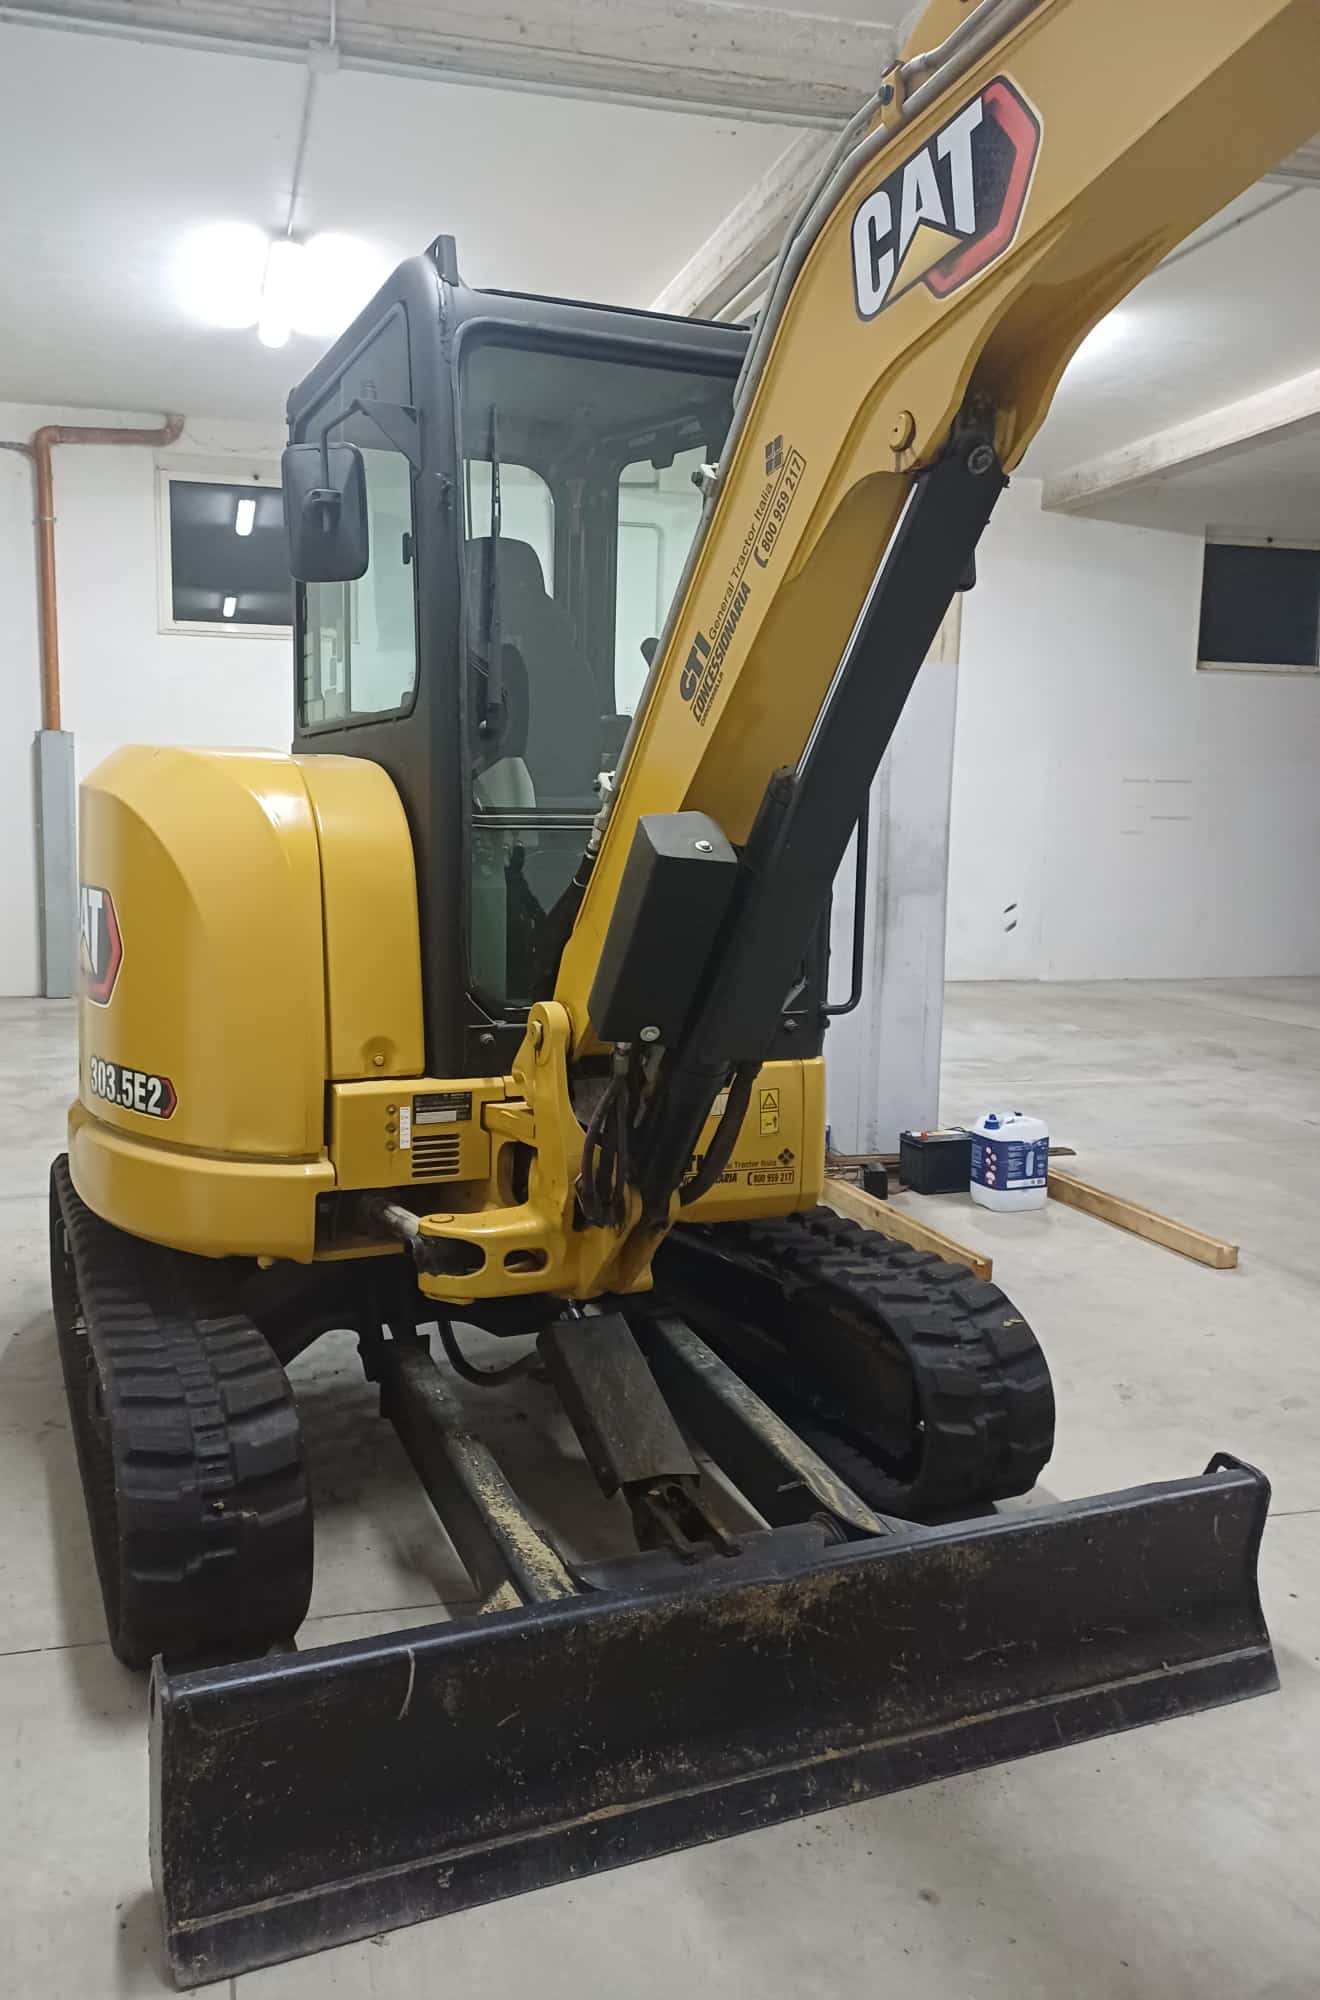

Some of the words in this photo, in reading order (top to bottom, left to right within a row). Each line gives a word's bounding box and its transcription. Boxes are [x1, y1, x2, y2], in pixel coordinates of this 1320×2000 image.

[853, 96, 983, 316] CAT
[761, 522, 778, 553] 800
[773, 491, 790, 522] 959
[785, 457, 802, 491] 217
[680, 631, 712, 702] GTI
[708, 577, 736, 640] General
[731, 522, 757, 580] Tractor
[753, 482, 774, 519] Italia
[693, 581, 752, 723] CONCESSIONARIA
[80, 886, 104, 976] AT
[90, 1056, 164, 1116] 303.5E2
